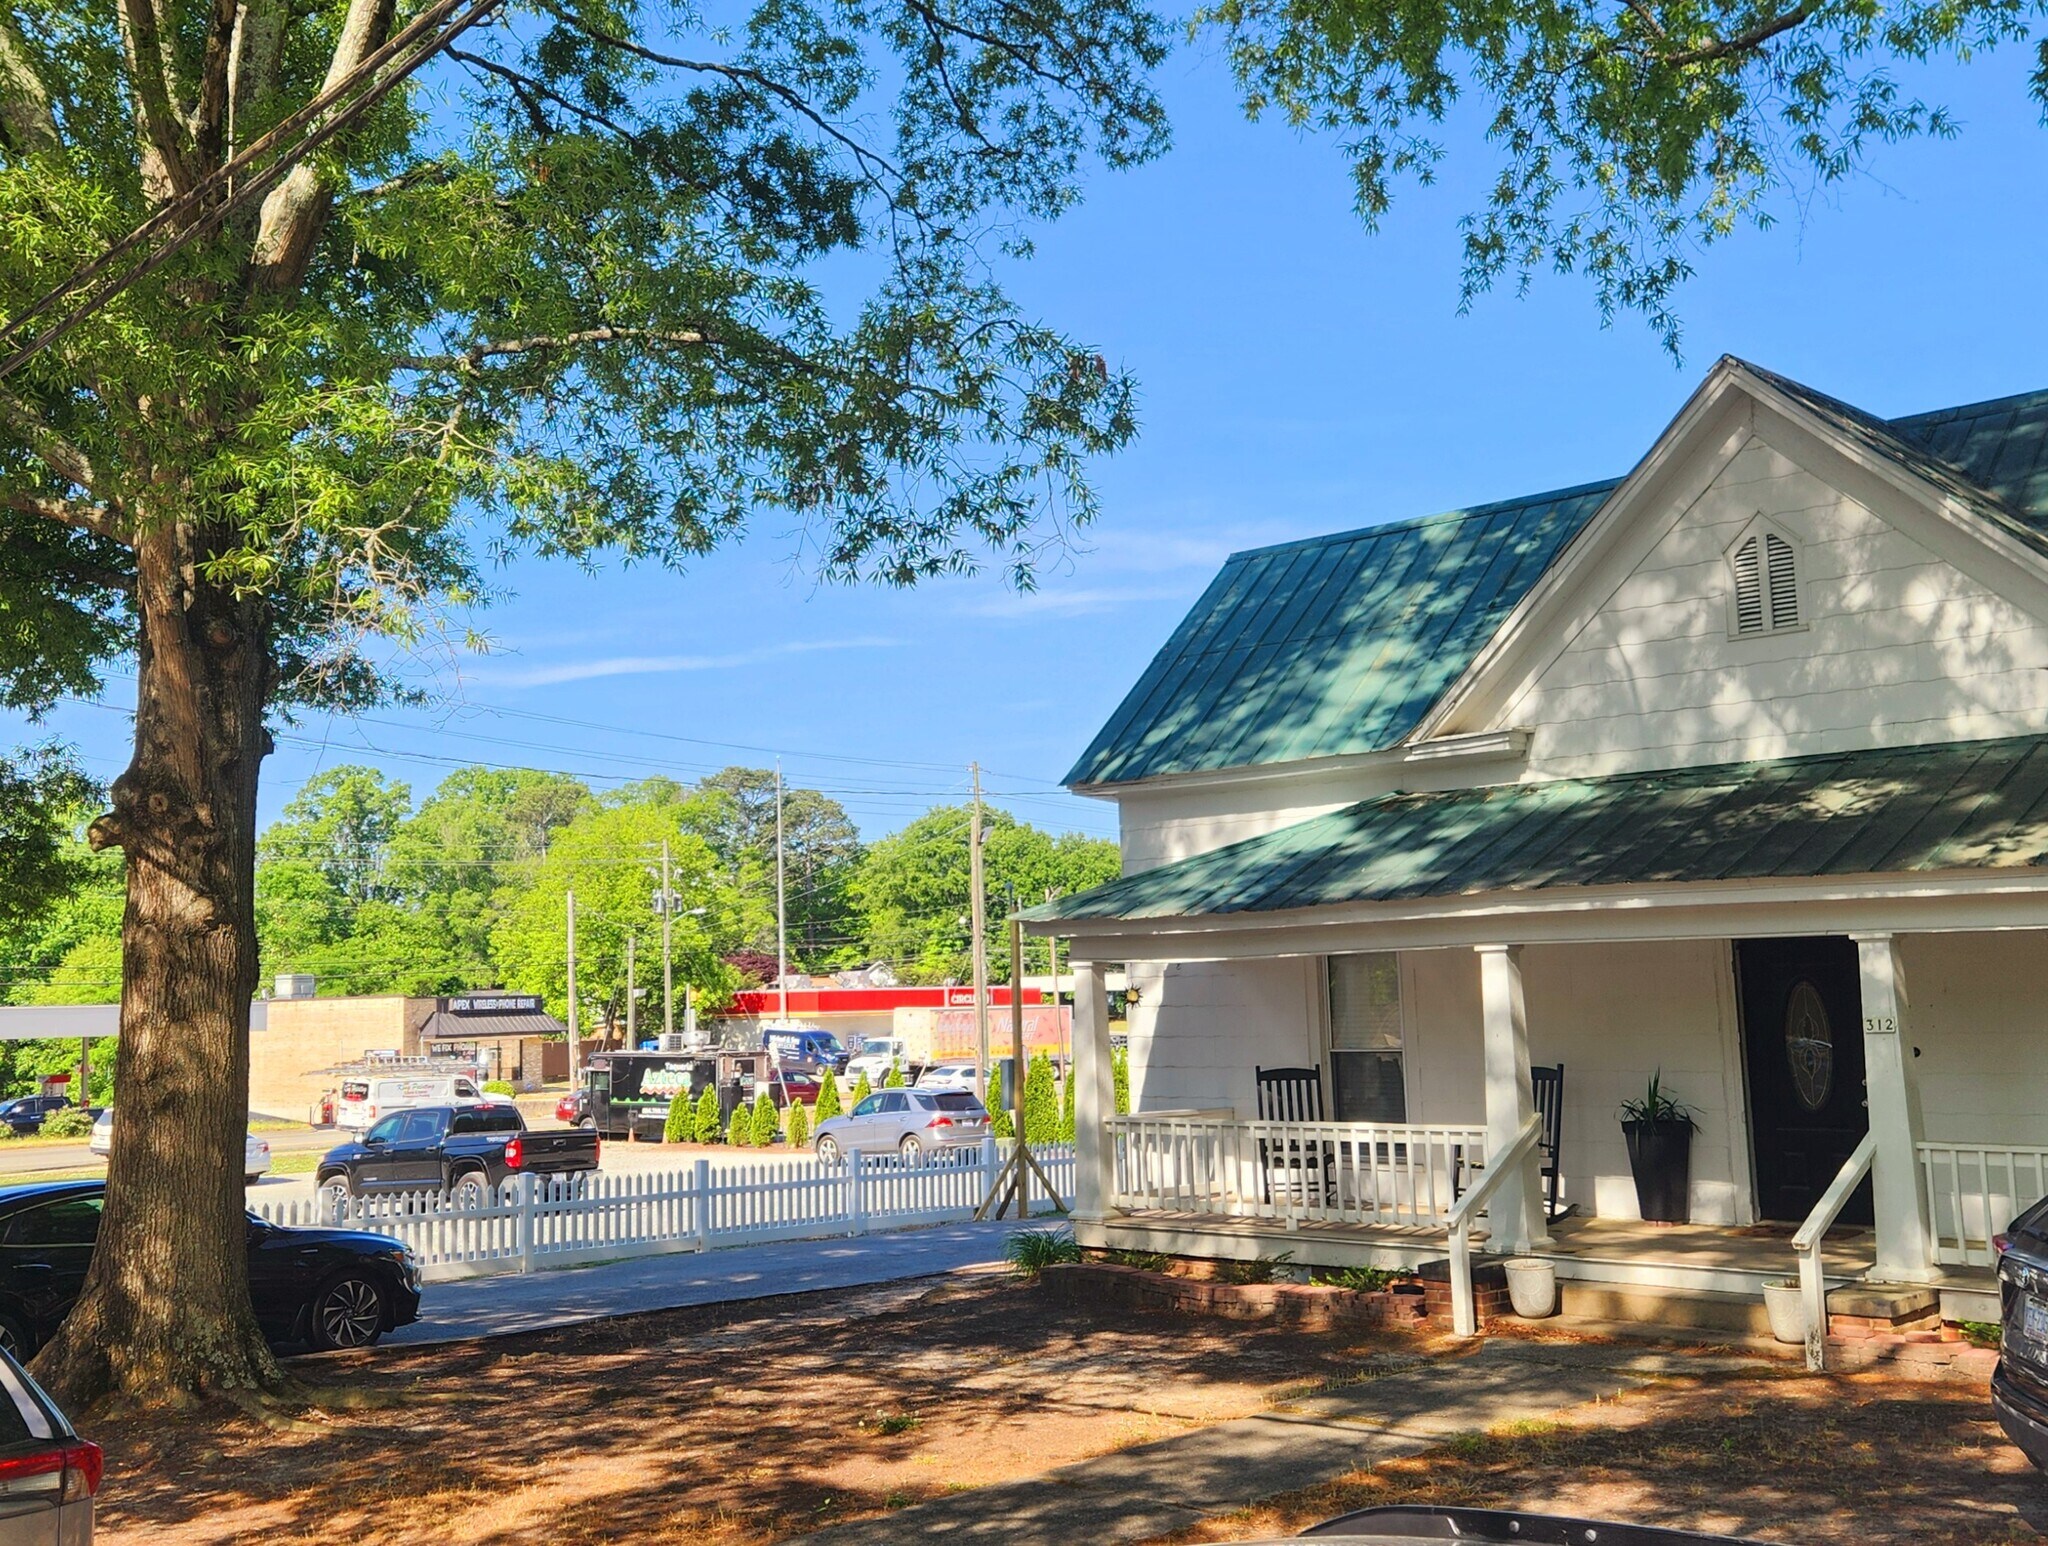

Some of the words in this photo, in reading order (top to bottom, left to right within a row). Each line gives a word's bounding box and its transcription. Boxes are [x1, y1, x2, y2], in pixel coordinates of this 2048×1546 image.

[453, 999, 470, 1010] APEX
[517, 998, 536, 1009] REPAIR
[950, 993, 977, 1004] CIRCL
[1866, 1018, 1893, 1031] 312
[641, 1067, 692, 1087] Azteca
